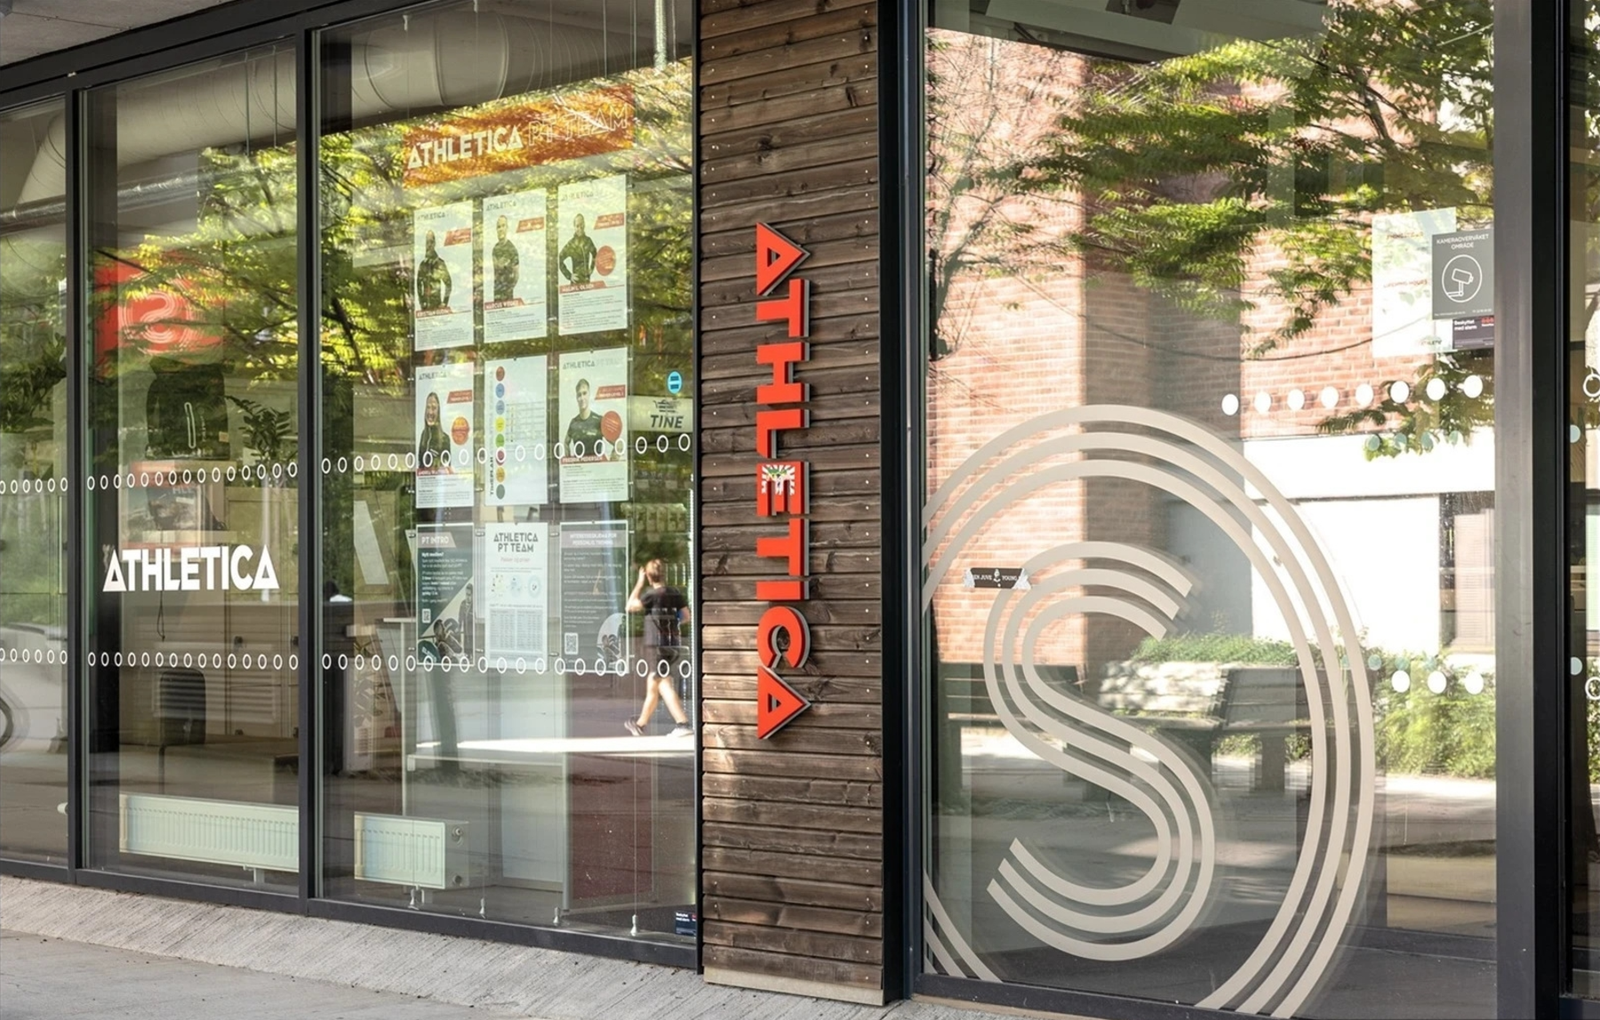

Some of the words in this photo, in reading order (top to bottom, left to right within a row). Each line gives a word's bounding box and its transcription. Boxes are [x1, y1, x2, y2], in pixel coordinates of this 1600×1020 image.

[407, 126, 524, 169] ATHLETICA
[1451, 242, 1475, 250] OMRÅDE
[650, 414, 684, 429] TINE
[757, 222, 811, 740] ATHLETICA
[421, 536, 430, 544] PT
[430, 536, 449, 544] INTRO
[493, 532, 538, 542] ATHLETICA
[498, 543, 509, 552] PT
[510, 543, 534, 552] TEAM
[103, 544, 280, 592] ATHLETICA
